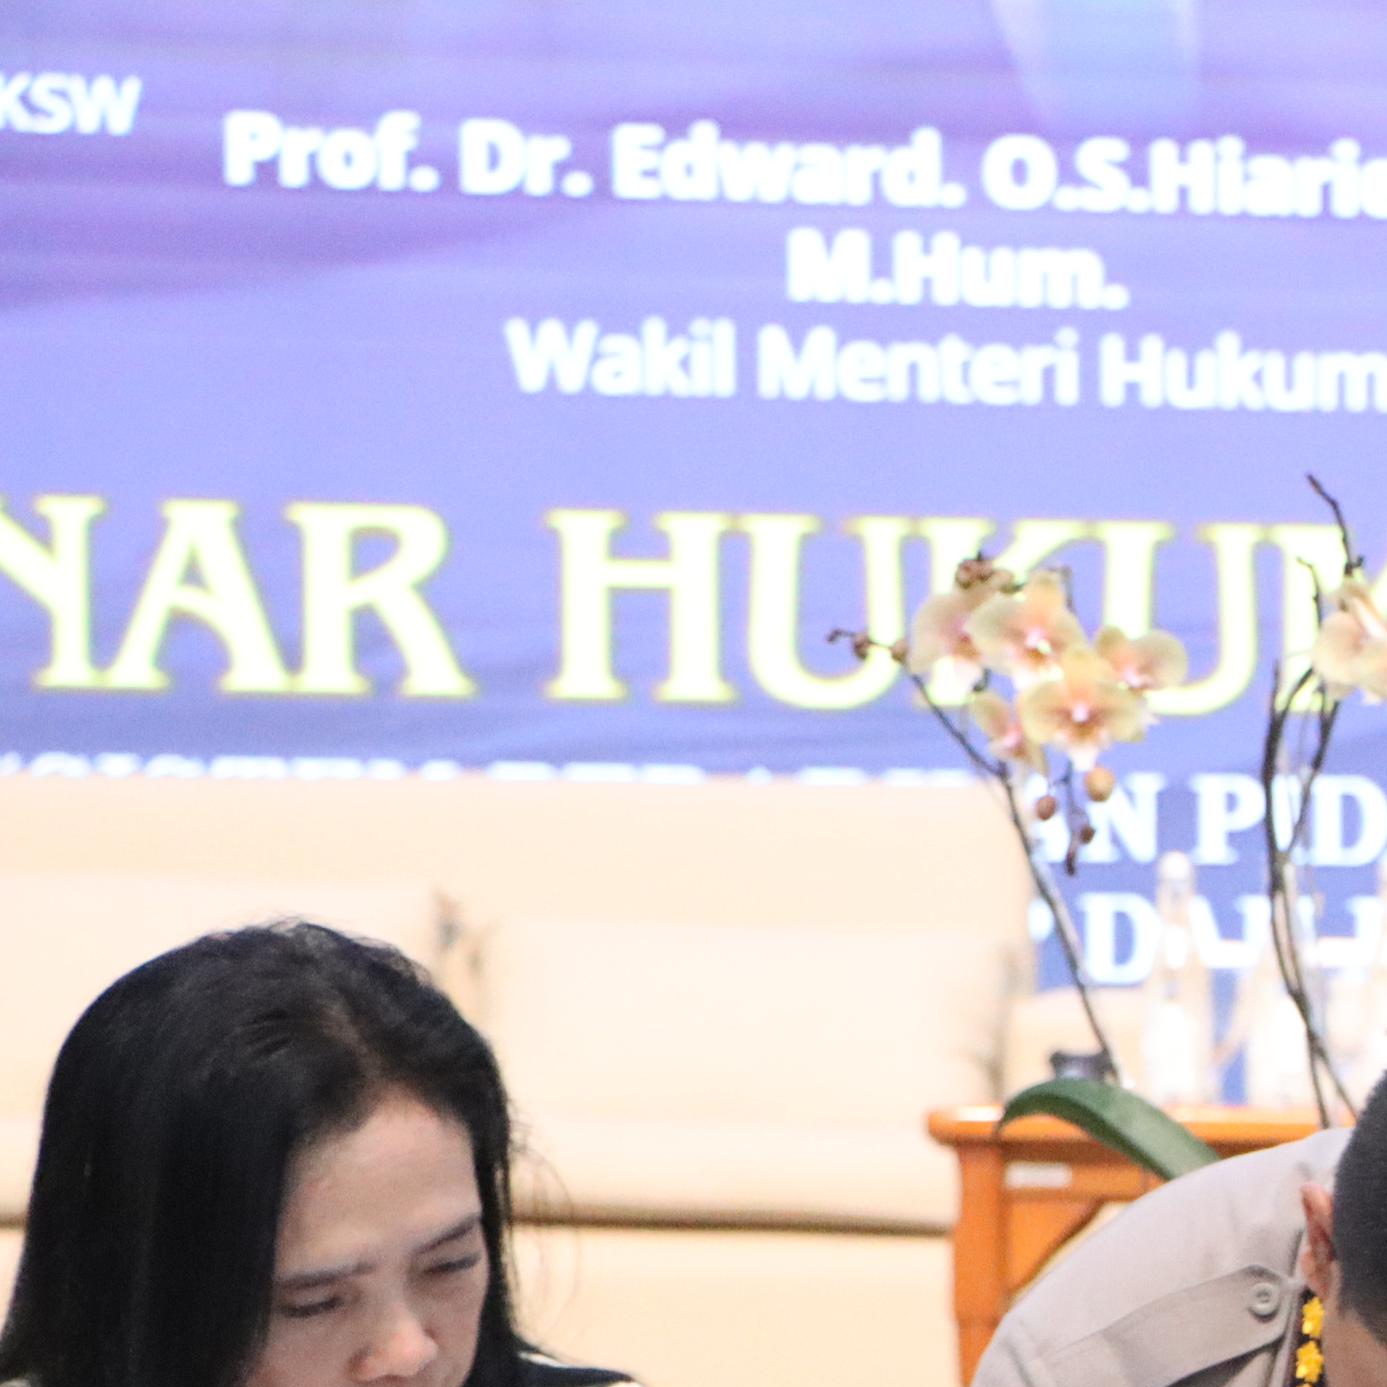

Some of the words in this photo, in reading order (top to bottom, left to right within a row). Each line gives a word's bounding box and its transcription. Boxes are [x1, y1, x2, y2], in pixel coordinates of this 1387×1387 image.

[223, 110, 440, 191] Prof.
[459, 118, 592, 196] Dr.
[611, 120, 967, 208] Edward.
[786, 227, 1131, 310] M.Hum.
[505, 316, 737, 397] Wakil
[757, 324, 1080, 406] Menteri
